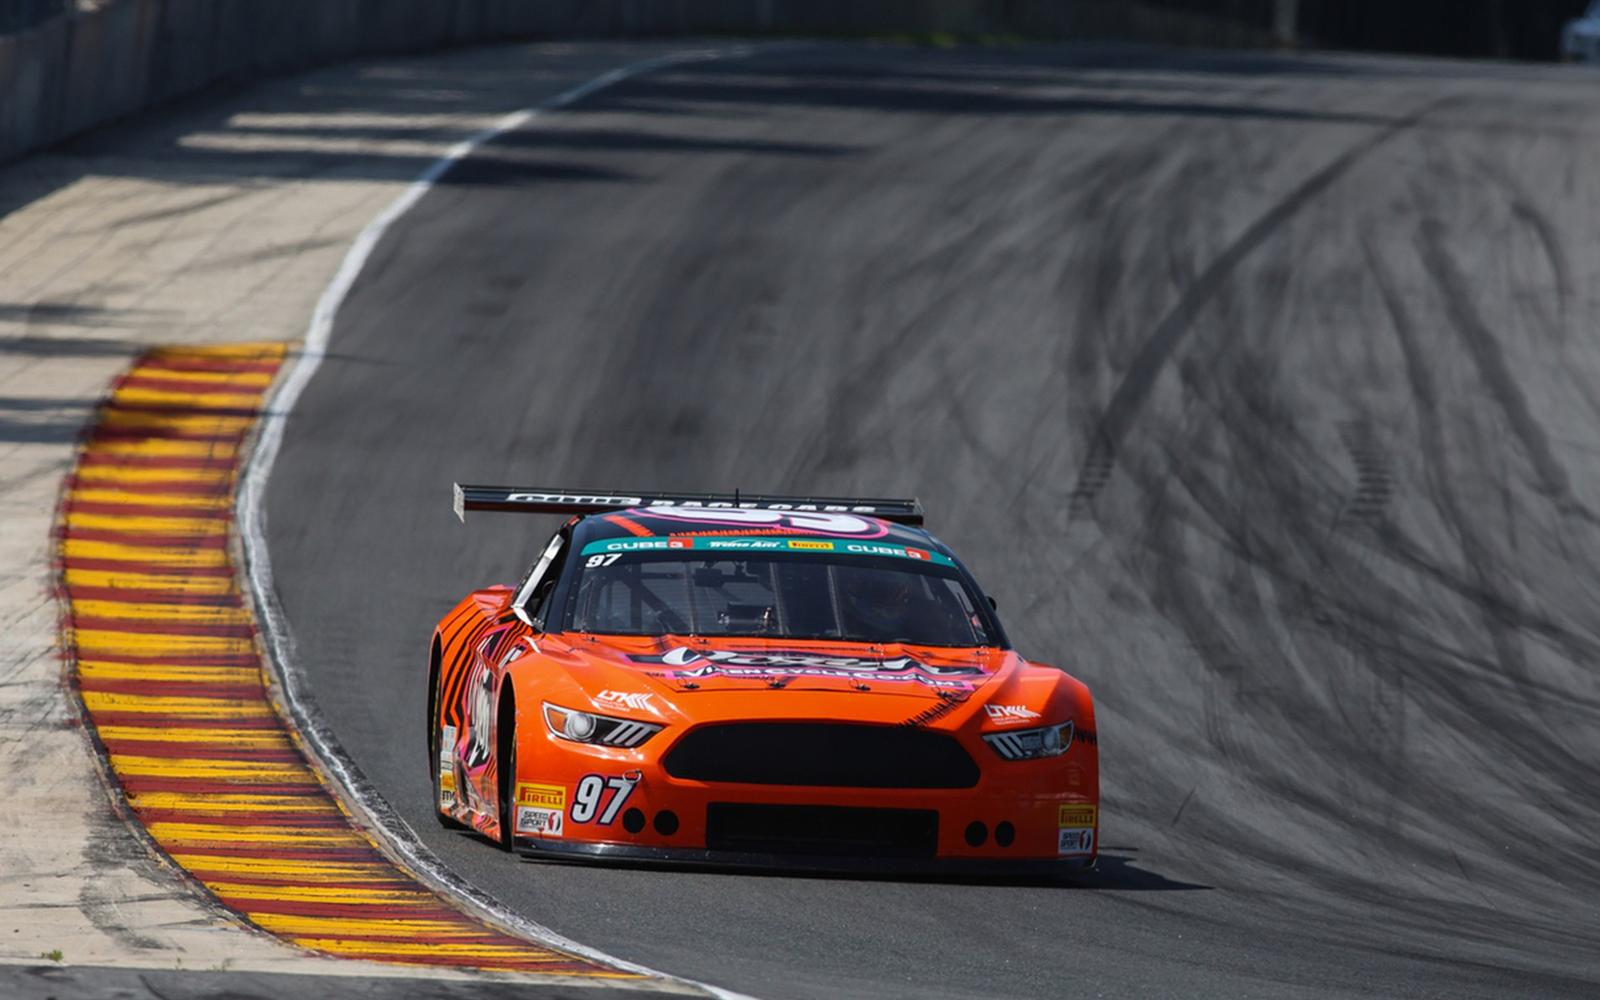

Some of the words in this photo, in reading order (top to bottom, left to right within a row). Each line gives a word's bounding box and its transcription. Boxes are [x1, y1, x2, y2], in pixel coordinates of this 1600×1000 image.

[586, 553, 623, 568] 97
[519, 786, 564, 805] PIRELLI
[571, 773, 641, 825] 97
